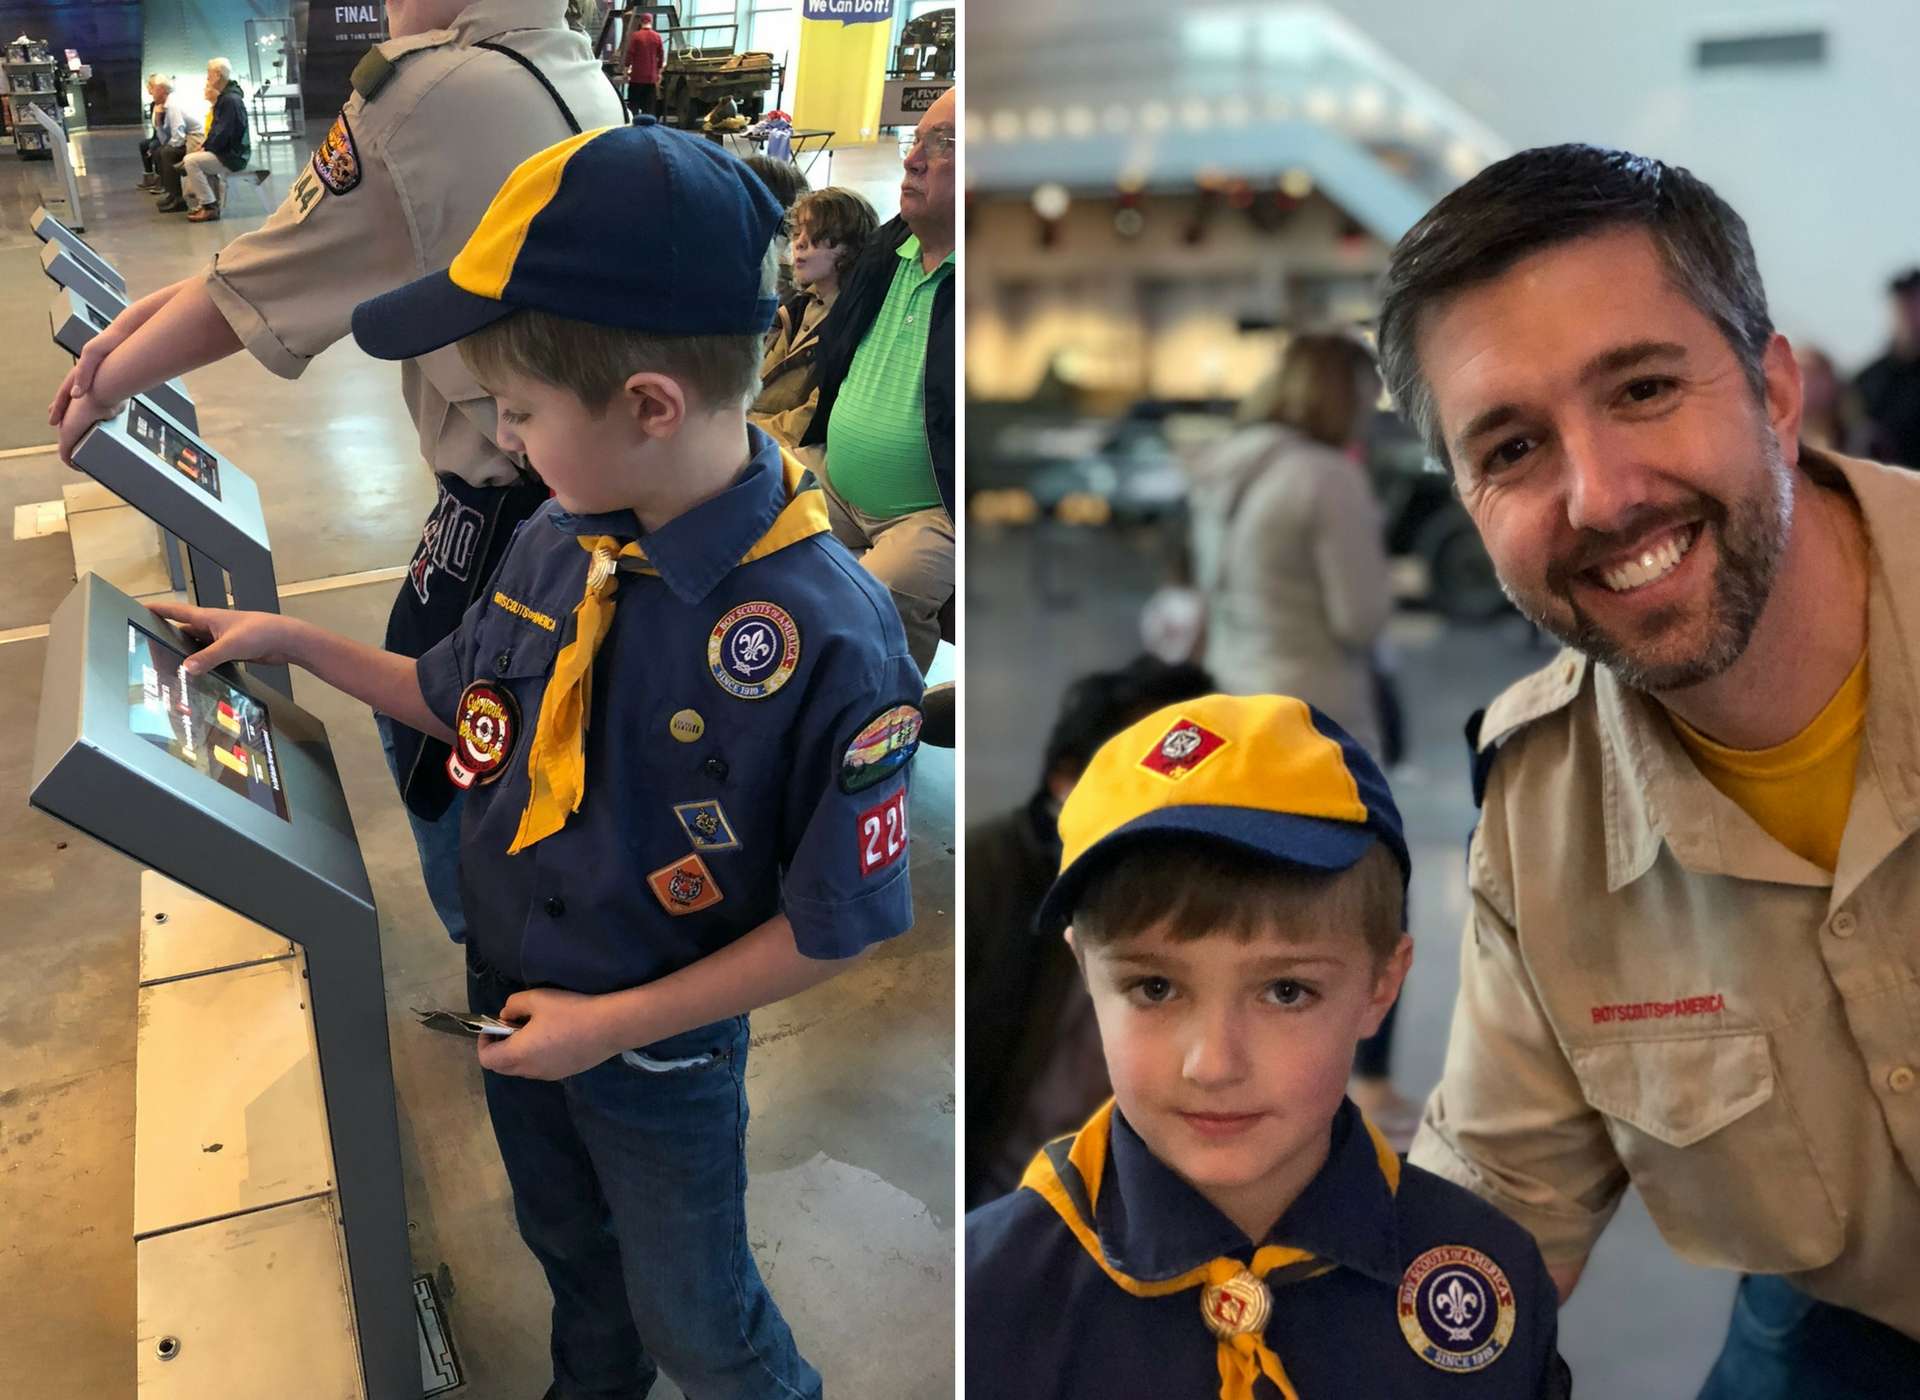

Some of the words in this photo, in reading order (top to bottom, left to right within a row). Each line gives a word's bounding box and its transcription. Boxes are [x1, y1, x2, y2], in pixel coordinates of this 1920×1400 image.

[335, 6, 378, 24] FINAL
[809, 0, 827, 12] We
[829, 0, 852, 12] Can
[855, 0, 872, 12] Do
[874, 0, 890, 12] It!
[737, 604, 772, 618] SCOUTS
[778, 613, 798, 661] AMERICA
[716, 670, 740, 694] SINCE
[1413, 1250, 1450, 1281] SCOUTS
[1464, 1250, 1510, 1298] AMERICA
[1434, 1351, 1471, 1368] SINCE
